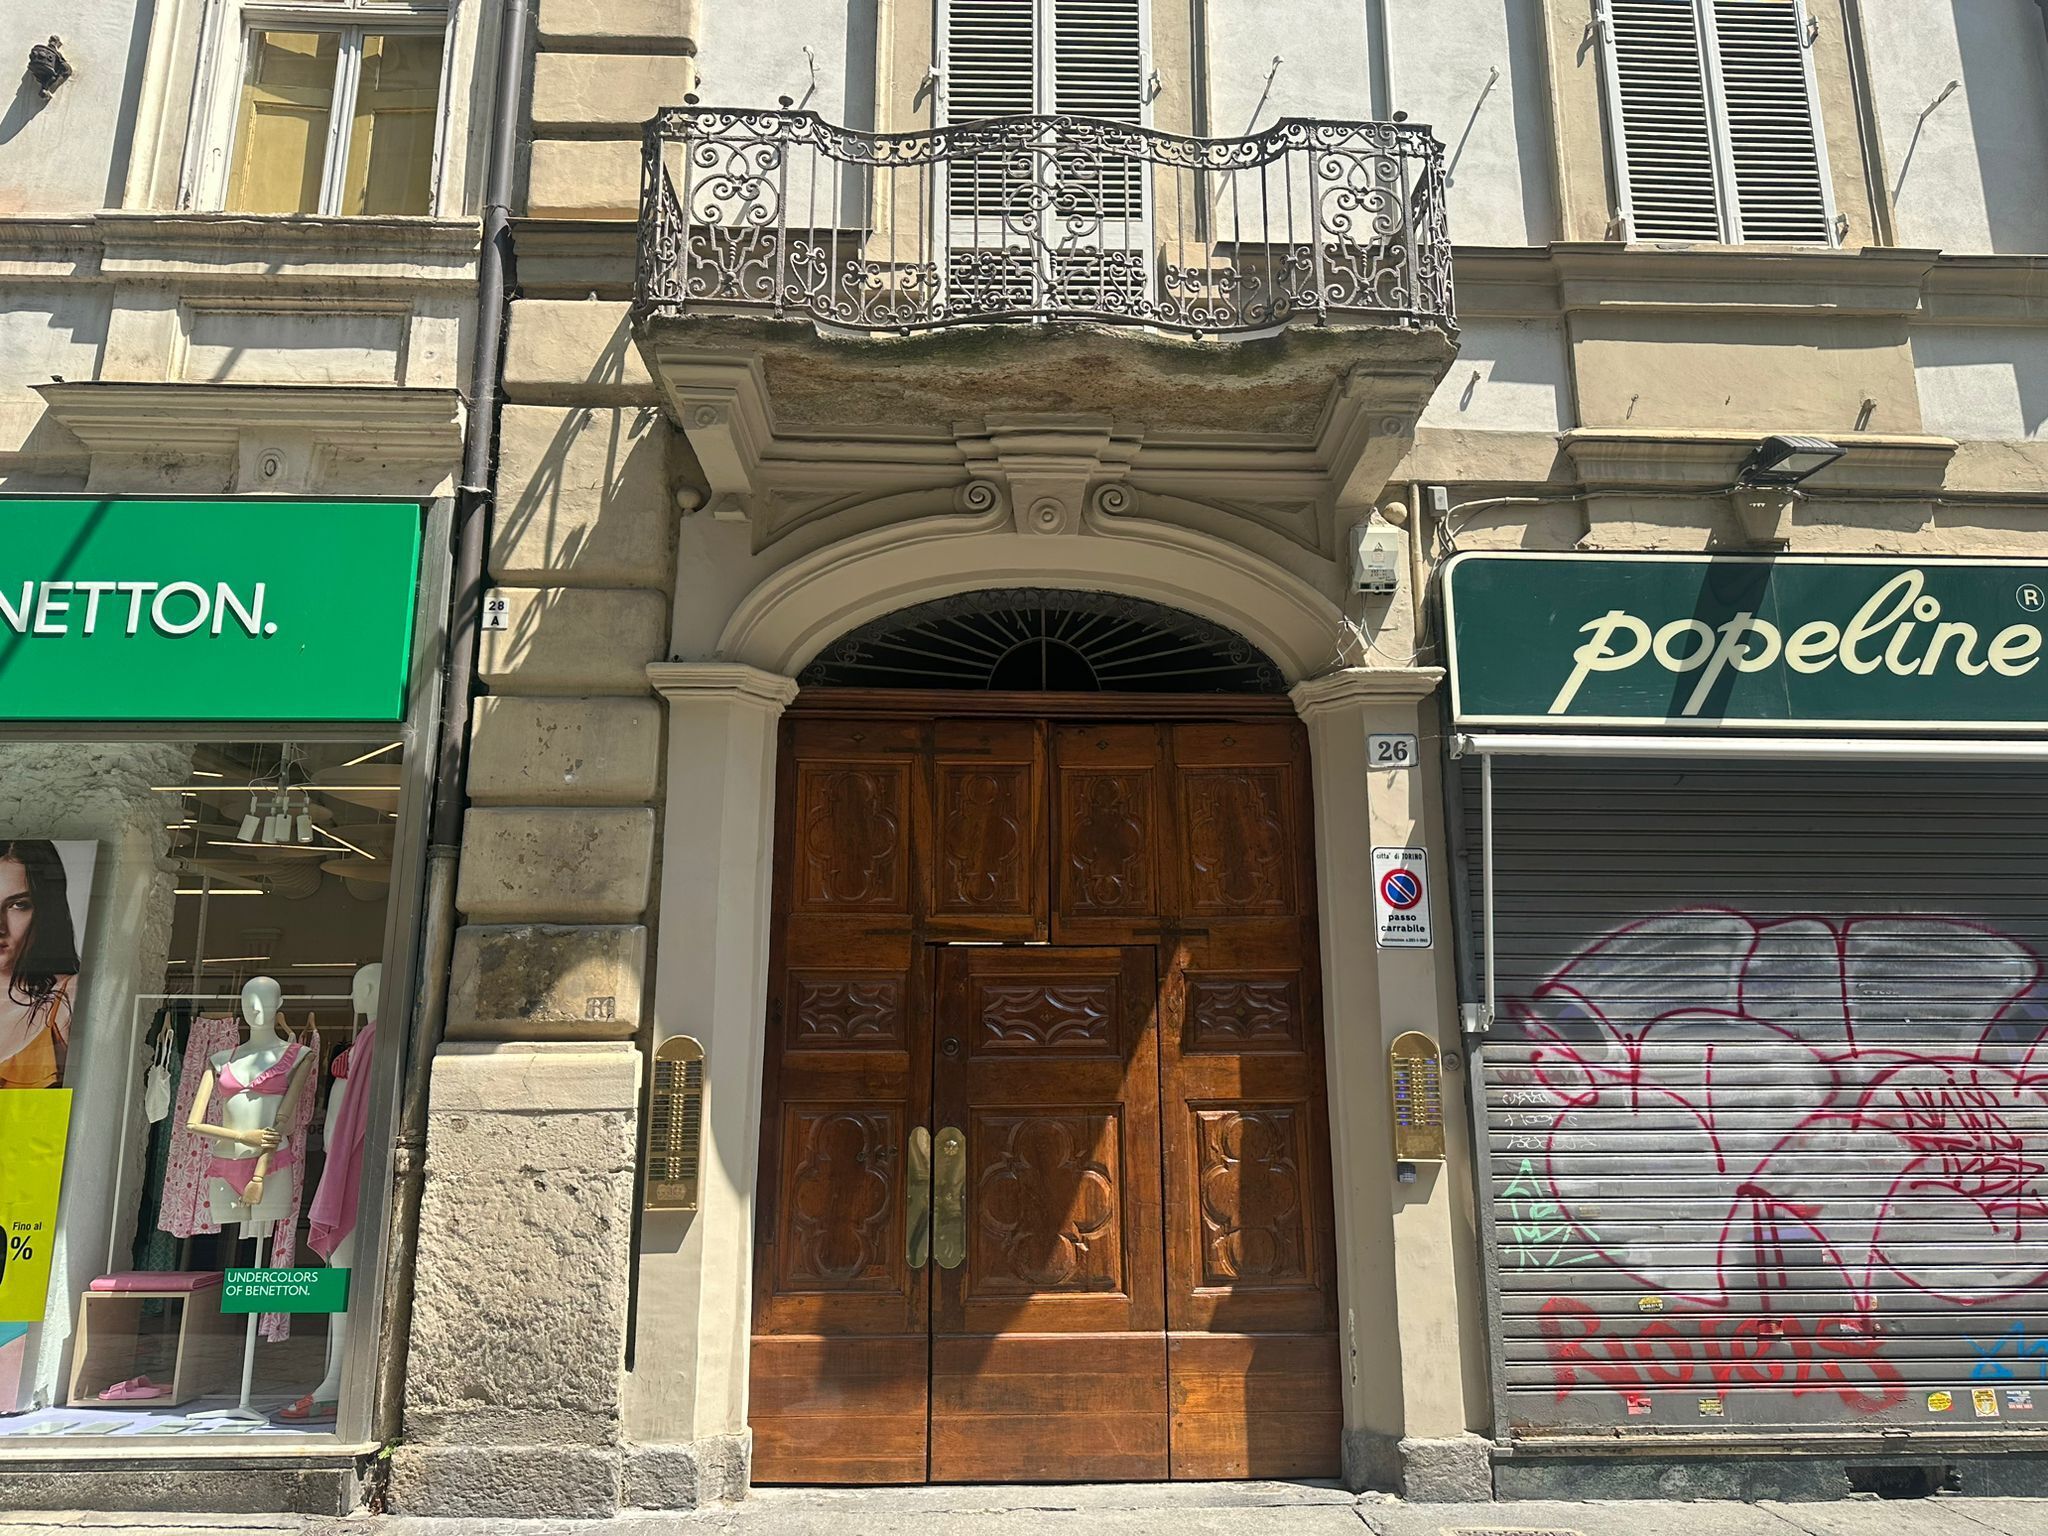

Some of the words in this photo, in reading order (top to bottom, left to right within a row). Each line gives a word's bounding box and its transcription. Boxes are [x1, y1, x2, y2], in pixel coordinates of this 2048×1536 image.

[489, 601, 505, 611] 28
[491, 616, 500, 626] A
[1547, 569, 2042, 716] popeline
[1378, 741, 1408, 761] 26
[1388, 914, 1417, 922] passo
[1380, 924, 1426, 933] carrabile
[12, 1221, 32, 1231] Fino
[33, 1221, 42, 1231] al
[227, 1271, 319, 1283] UNDERCOLORS
[225, 1285, 243, 1296] OF
[245, 1285, 311, 1296] BENETTON.
